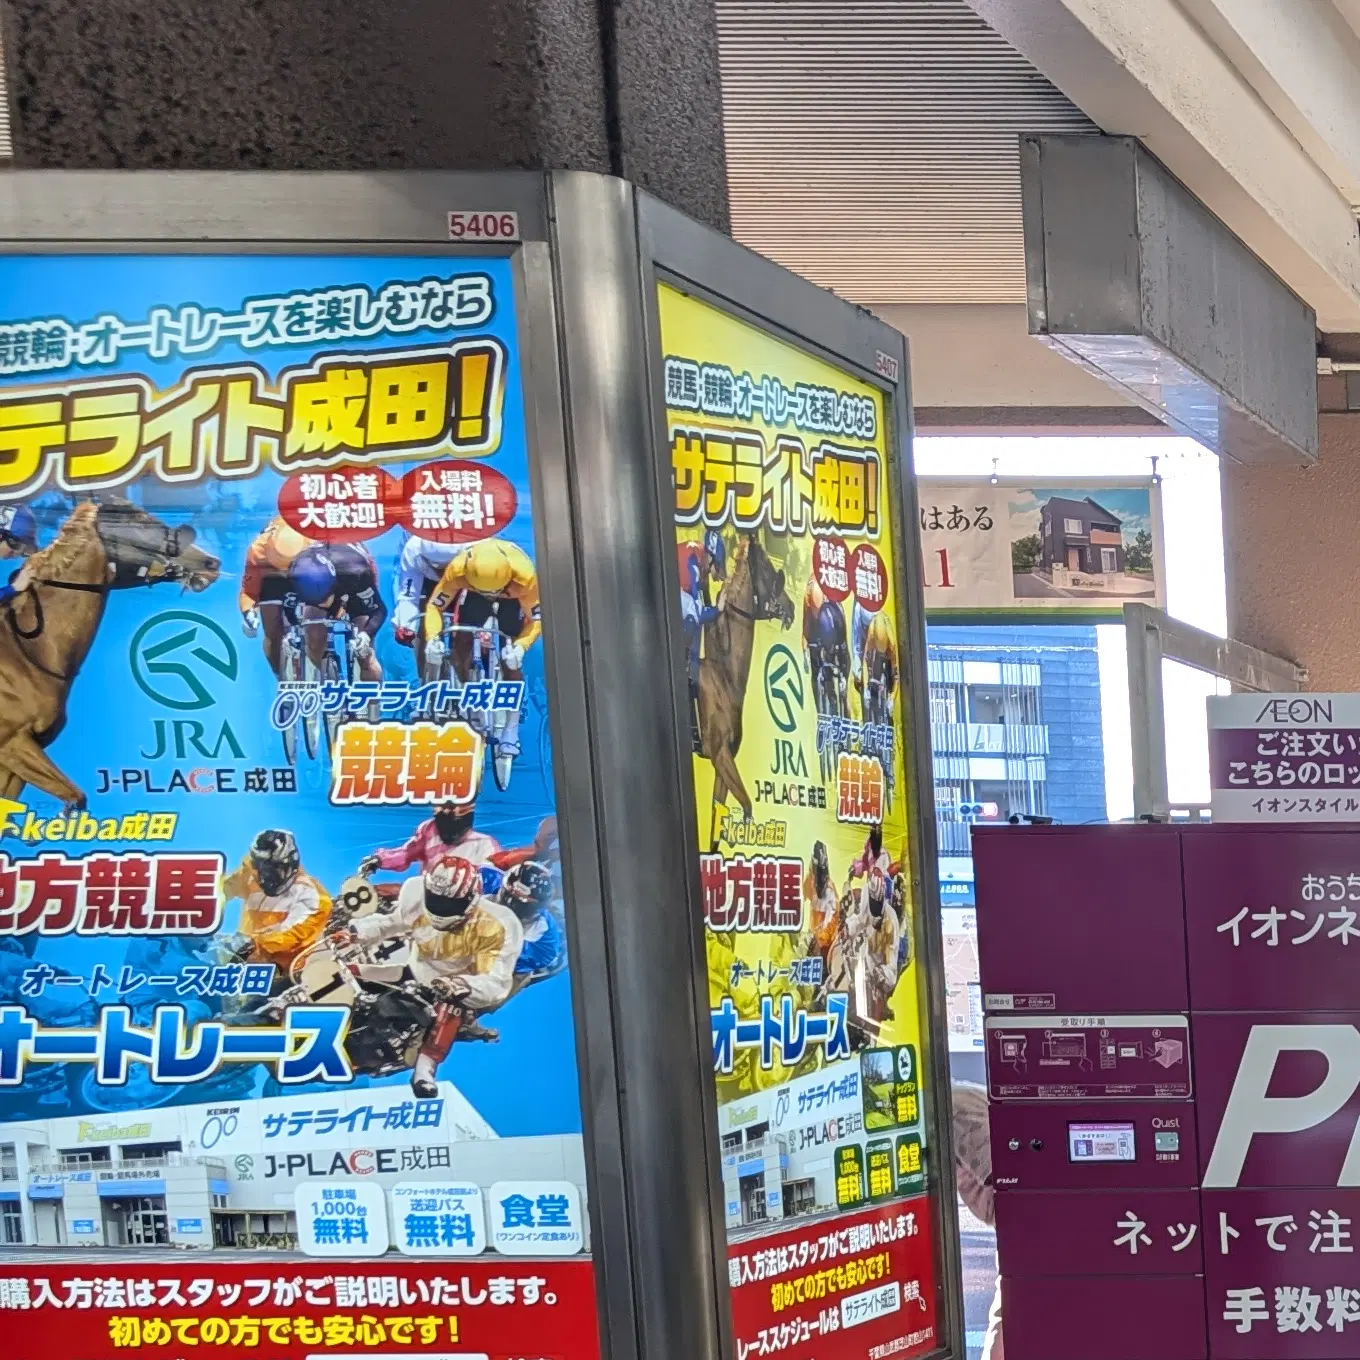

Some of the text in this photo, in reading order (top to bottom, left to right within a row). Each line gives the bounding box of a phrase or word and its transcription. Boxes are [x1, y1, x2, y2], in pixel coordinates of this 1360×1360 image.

[450, 215, 515, 239] 5406
[299, 473, 378, 500] 初心者
[420, 470, 483, 493] 入場料
[671, 432, 878, 532] サテライト成田!
[298, 502, 386, 529] 大歓迎!
[411, 494, 496, 530] 無料!
[320, 680, 524, 712] サテライト成田
[140, 719, 247, 761] JRA
[334, 722, 479, 801] 競輪
[770, 738, 809, 778] JRA
[97, 766, 298, 794] J-PLACE 成田
[754, 779, 806, 807] J-PLACE
[838, 753, 884, 822] 競輪
[0, 855, 219, 931] 方競馬
[701, 856, 803, 930] 地方競馬
[22, 964, 274, 996] オートレース成田
[710, 993, 850, 1073] オートレース
[262, 1098, 445, 1138] サテライト成田
[799, 1116, 846, 1151] J-PLACE
[264, 1145, 452, 1178] J-PLACE 成田
[311, 1201, 368, 1217] 1,000台
[321, 1188, 357, 1200] 駐車場
[409, 1198, 466, 1212] 送迎バス
[499, 1193, 572, 1229] 食堂
[312, 1217, 369, 1245] 無料
[403, 1213, 476, 1248] 無料
[844, 1286, 897, 1321] サテライト成田
[108, 1315, 460, 1348] 初めての方でも安心です!
